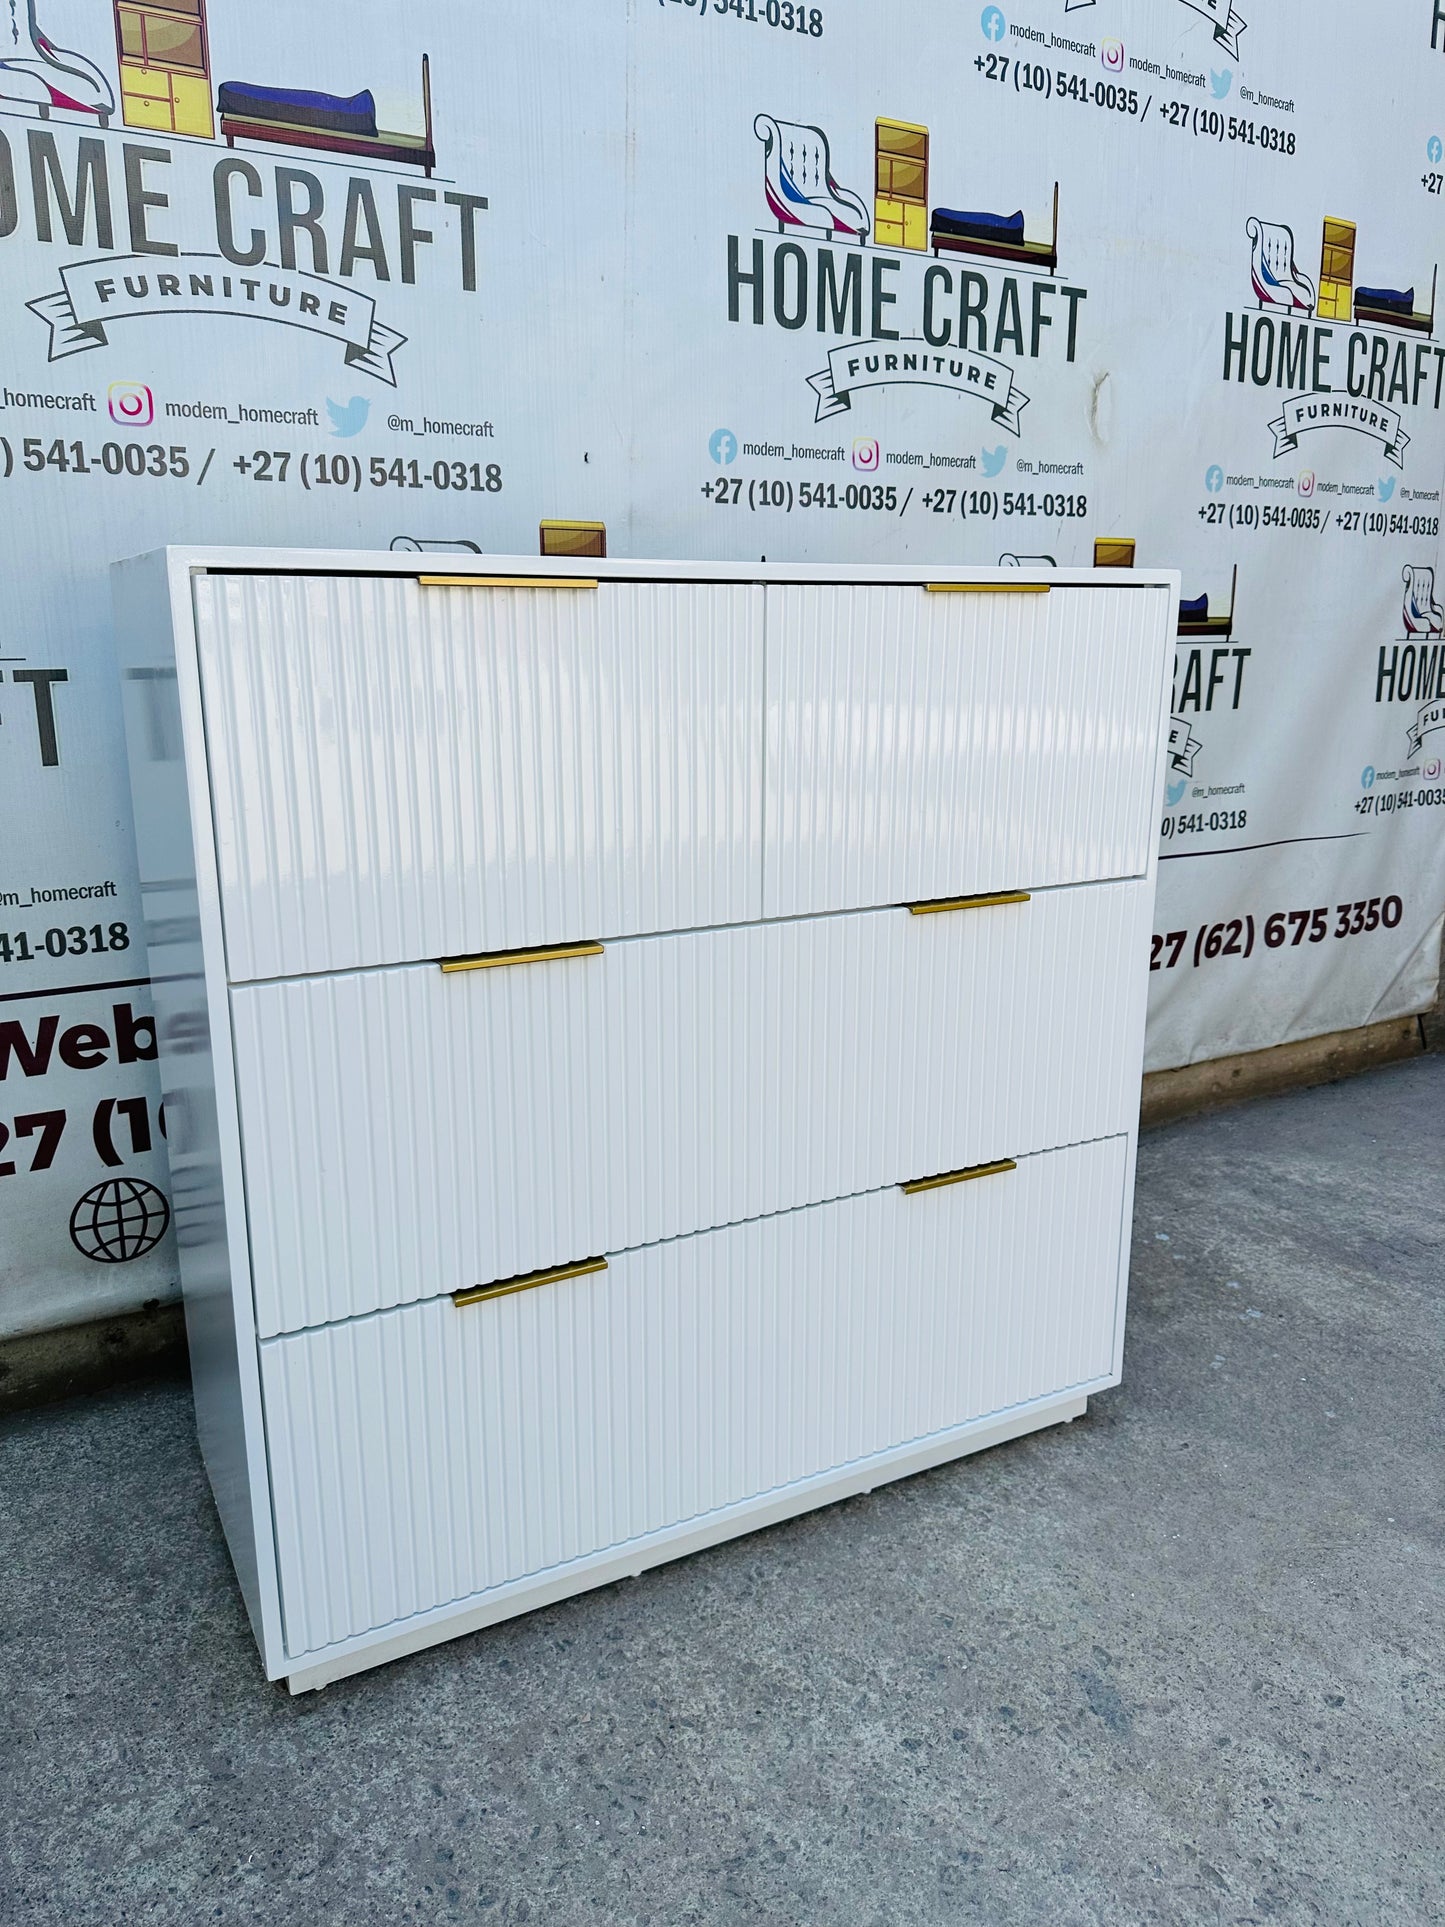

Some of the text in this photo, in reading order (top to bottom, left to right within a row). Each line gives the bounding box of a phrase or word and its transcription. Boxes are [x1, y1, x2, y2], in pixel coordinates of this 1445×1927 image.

[974, 54, 1009, 82] +27
[1014, 61, 1051, 99] (10)
[1056, 66, 1138, 114] 541-0035
[1160, 102, 1189, 127] +27
[1193, 108, 1224, 142] (10)
[1228, 117, 1295, 155] 541-0318
[1421, 173, 1443, 194] +27
[0, 128, 489, 292] ME CRAFT
[95, 273, 349, 326] FURNITURE
[727, 234, 1087, 363] HOME CRAFT
[848, 353, 997, 390] FURNITURE
[1223, 311, 1445, 409] HOME CRAFT
[388, 415, 494, 437] @m_homecraft
[1295, 403, 1389, 432] FURNITURE
[24, 438, 189, 477] 541-0035
[233, 451, 290, 481] +27
[301, 454, 361, 492] (10)
[370, 457, 502, 492] 541-0318
[1017, 459, 1083, 475] @m_homecraft
[701, 478, 742, 504] +27
[749, 480, 793, 512] (10)
[799, 483, 896, 511] 541-0035
[923, 489, 956, 513] +27
[961, 491, 998, 520] (10)
[1003, 493, 1086, 517] 541-0318
[1199, 503, 1225, 523] +27
[1230, 504, 1259, 529] (10)
[1263, 506, 1320, 529] 541-0035
[1336, 512, 1360, 530] +27
[1363, 513, 1387, 536] (10)
[1390, 515, 1438, 536] 541-0318
[1171, 648, 1251, 713] AFT
[1178, 810, 1246, 834] 541-0318
[1355, 796, 1377, 815] +27
[1375, 794, 1396, 815] (10)
[1194, 915, 1254, 967] (62)
[1264, 908, 1328, 948] 675
[1334, 895, 1402, 938] 3350
[93, 1096, 168, 1168] (1
